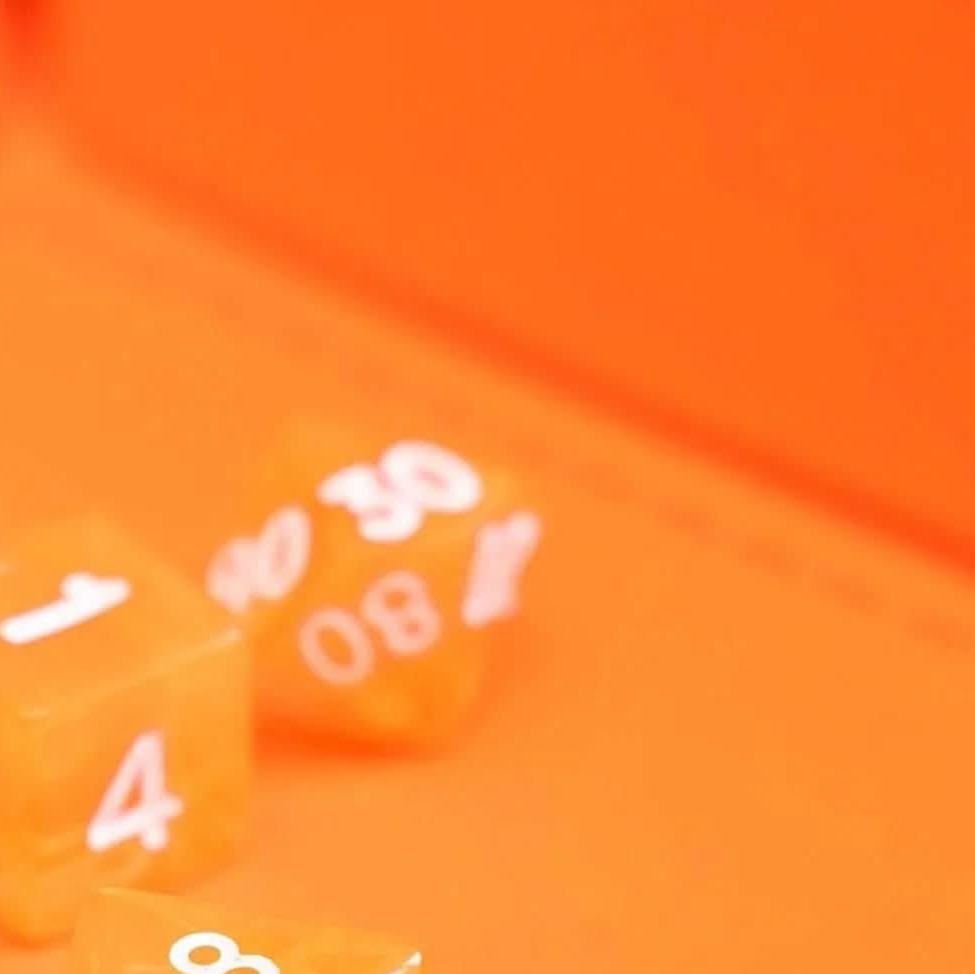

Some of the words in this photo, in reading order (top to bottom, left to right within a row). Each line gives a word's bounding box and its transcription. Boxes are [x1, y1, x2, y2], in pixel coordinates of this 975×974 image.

[0, 571, 130, 645] 1
[298, 568, 442, 685] 80
[86, 730, 184, 852] 4
